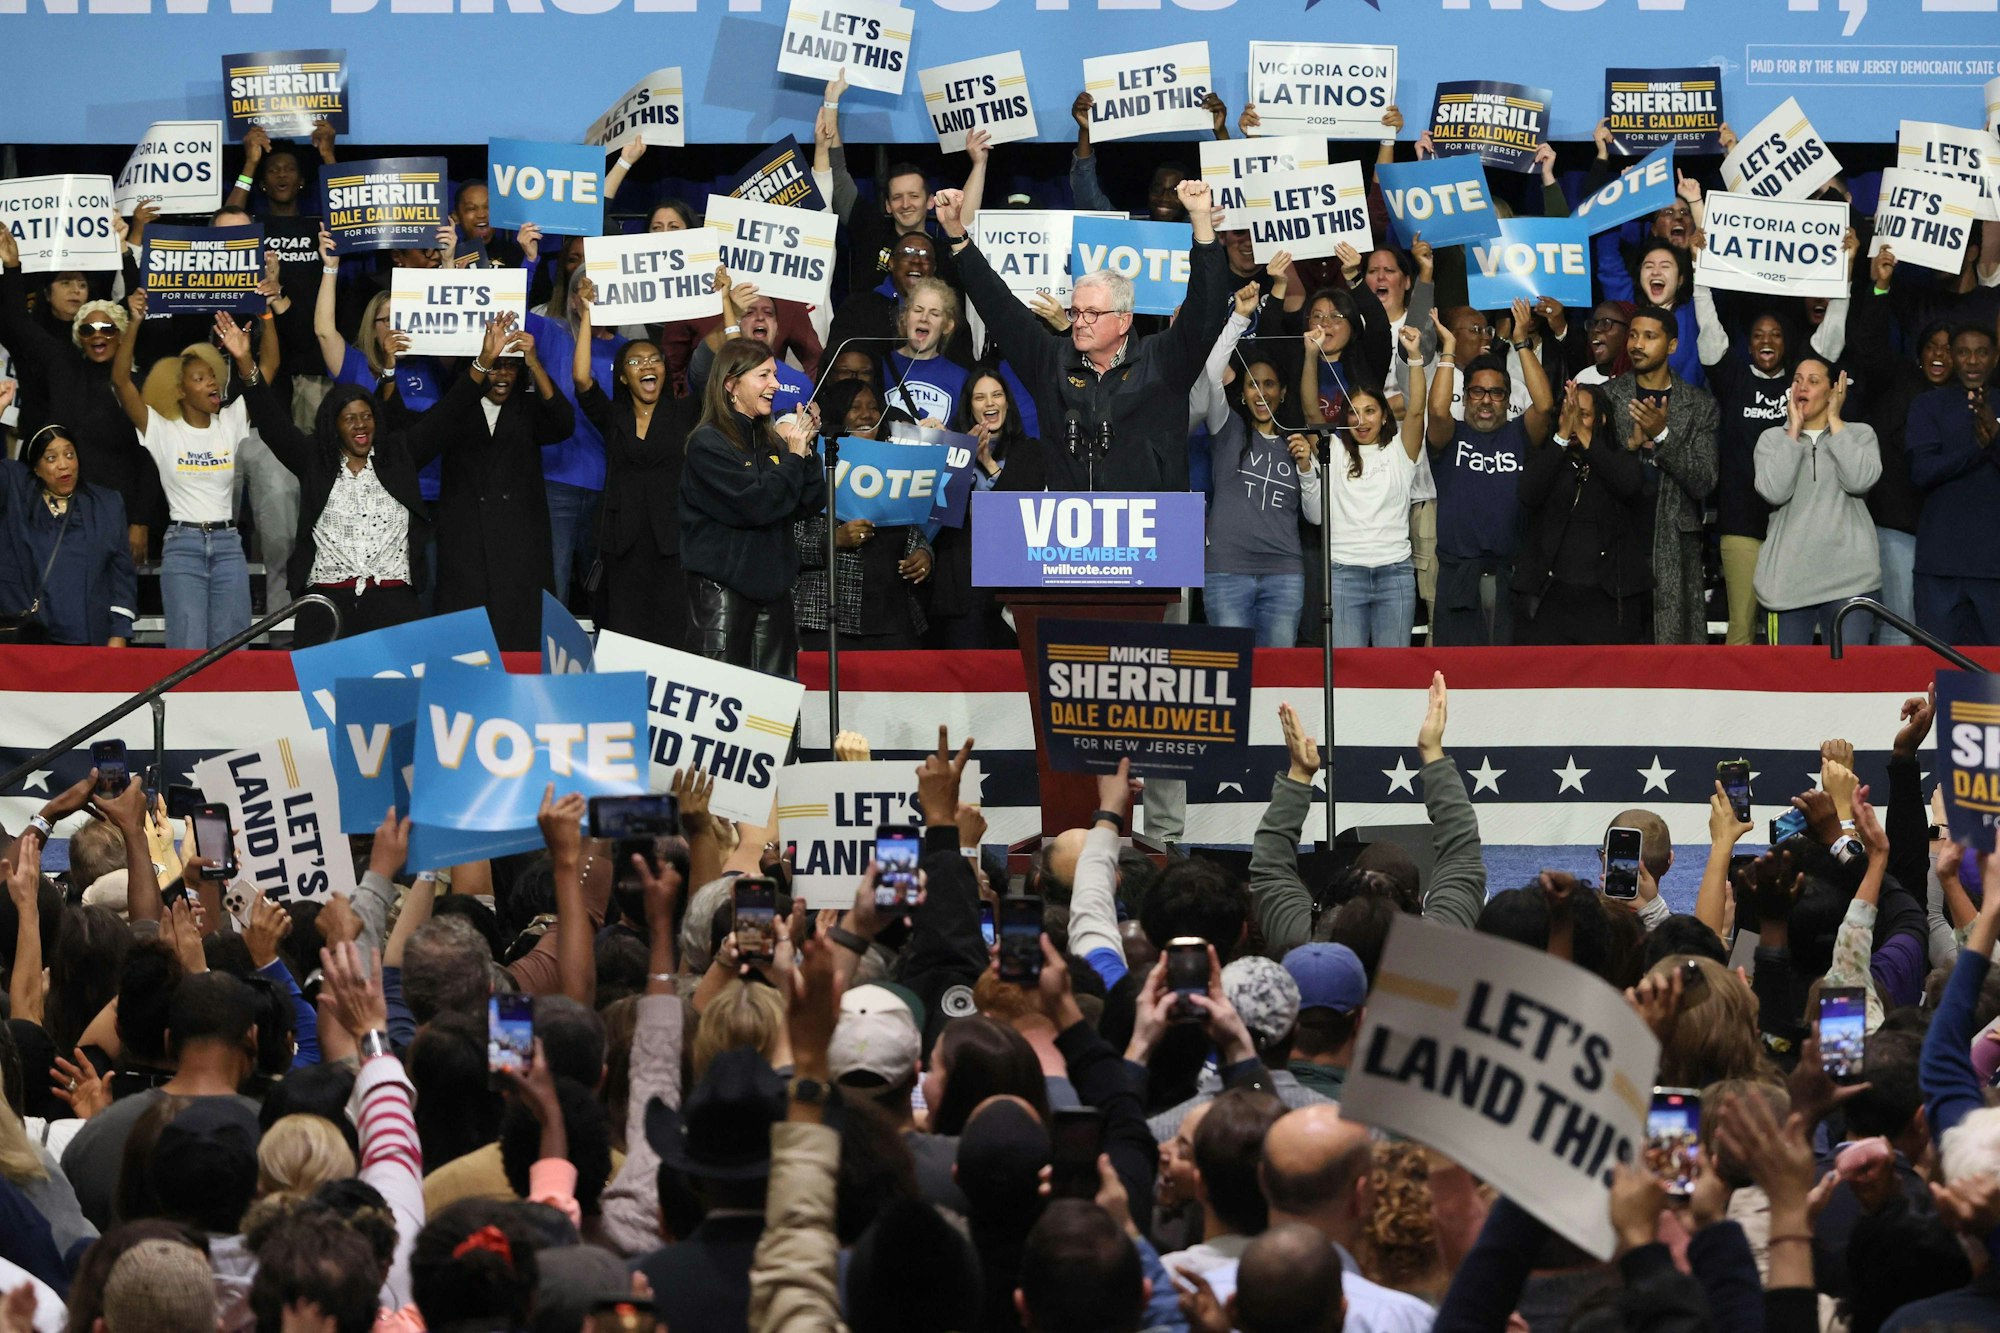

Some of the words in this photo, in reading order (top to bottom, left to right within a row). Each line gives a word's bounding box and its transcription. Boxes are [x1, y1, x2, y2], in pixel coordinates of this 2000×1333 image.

[820, 10, 880, 40] LET'S
[786, 32, 848, 62] LAND
[852, 42, 903, 72] THIS
[268, 64, 303, 74] MIKIE
[1118, 63, 1177, 91] LET'S
[1259, 62, 1343, 76] VICTORIA
[1348, 64, 1387, 78] CON
[1750, 59, 1774, 74] PAID
[1776, 59, 1796, 74] FOR
[1799, 59, 1812, 74] BY
[1815, 60, 1834, 74] THE
[1836, 60, 1860, 74] NEW
[1862, 60, 1898, 75] JERSEY
[1901, 60, 1964, 75] DEMOCRATIC
[1966, 60, 1994, 75] STATE
[230, 73, 342, 98] SHERRILL
[945, 75, 996, 104] LET'S
[1258, 83, 1386, 108] LATINOS
[1648, 82, 1682, 92] MIKIE
[232, 98, 266, 114] DALE
[270, 94, 342, 111] CALDWELL
[604, 88, 650, 130] LET'S
[1092, 95, 1151, 122] LAND
[1153, 86, 1207, 110] THIS
[1472, 94, 1507, 104] MIKIE
[1610, 91, 1718, 113] SHERRILL
[628, 105, 679, 128] THIS
[932, 108, 976, 134] LAND
[976, 96, 1028, 124] THIS
[1306, 116, 1336, 125] 2025
[1436, 104, 1540, 132] SHERRILL
[1610, 114, 1644, 128] DALE
[1649, 113, 1718, 128] CALDWELL
[174, 141, 212, 154] CON
[1434, 124, 1465, 138] DALE
[1468, 124, 1538, 148] CALDWELL
[1488, 145, 1523, 158] JERSEY
[1739, 132, 1788, 182] LET'S
[1926, 142, 1982, 170] LET'S
[118, 162, 212, 188] LATINOS
[365, 174, 400, 184] MIKIE
[1234, 156, 1295, 179] LET'S
[1751, 174, 1783, 198] ND
[1774, 138, 1824, 182] THIS
[493, 164, 598, 204] VOTE
[740, 170, 764, 194] MIKIE
[1578, 157, 1669, 217] VOTE
[78, 196, 110, 208] CON
[328, 184, 440, 210] SHERRILL
[1210, 186, 1247, 209] LAN
[1274, 184, 1336, 212] LET'S
[1384, 180, 1488, 221] VOTE
[1889, 186, 1942, 216] LET'S
[10, 216, 110, 240] ATINOS
[330, 209, 362, 226] DALE
[366, 206, 440, 222] CALDWELL
[1252, 218, 1311, 244] LAND
[1312, 207, 1366, 236] THIS
[1712, 212, 1796, 234] VICTORIA
[1802, 222, 1840, 236] CON
[344, 229, 362, 238] FOR
[365, 227, 386, 235] NEW
[390, 226, 426, 234] JERSEY
[736, 218, 800, 248] LET'S
[1874, 214, 1907, 238] LAND
[1910, 218, 1964, 250] THIS
[39, 250, 69, 258] 205
[190, 241, 226, 250] MIKIE
[1708, 234, 1838, 266] LATINOS
[148, 250, 260, 272] SHERRILL
[622, 249, 685, 275] LET'S
[720, 245, 765, 273] AND
[770, 251, 825, 282] THIS
[1078, 243, 1190, 282] VOTE
[1472, 242, 1586, 278] VOTE
[148, 273, 184, 288] DALE
[188, 272, 260, 288] CALDWELL
[594, 281, 656, 306] LAND
[658, 272, 716, 298] THIS
[1756, 271, 1786, 282] 2025
[162, 292, 181, 300] FOR
[184, 292, 206, 300] NEW
[209, 292, 245, 300] JERSEY
[427, 286, 491, 306] LET'S
[395, 311, 459, 334] LAND
[1456, 440, 1524, 474] Facts.
[823, 454, 937, 499] VOTE
[1018, 498, 1156, 548] VOTE
[1027, 547, 1140, 562] NOVEMBER
[1145, 547, 1158, 562] 4
[1042, 564, 1132, 575] iwillvote.com
[1110, 646, 1170, 665] MIKIE
[1048, 662, 1237, 706] SHERRILL
[648, 675, 742, 733] LET'S
[1051, 702, 1099, 727] DALE
[1107, 704, 1236, 734] CALDWELL
[429, 704, 639, 782] VOTE
[1073, 737, 1098, 750] FOR
[1104, 739, 1140, 752] NEW
[1146, 741, 1208, 755] JERSEY
[691, 733, 776, 790] THIS
[227, 752, 280, 858] LAND
[282, 792, 329, 896] LET'S
[1464, 980, 1614, 1091] LET'S
[1362, 1024, 1528, 1128] LAND
[1529, 1079, 1636, 1190] THIS
